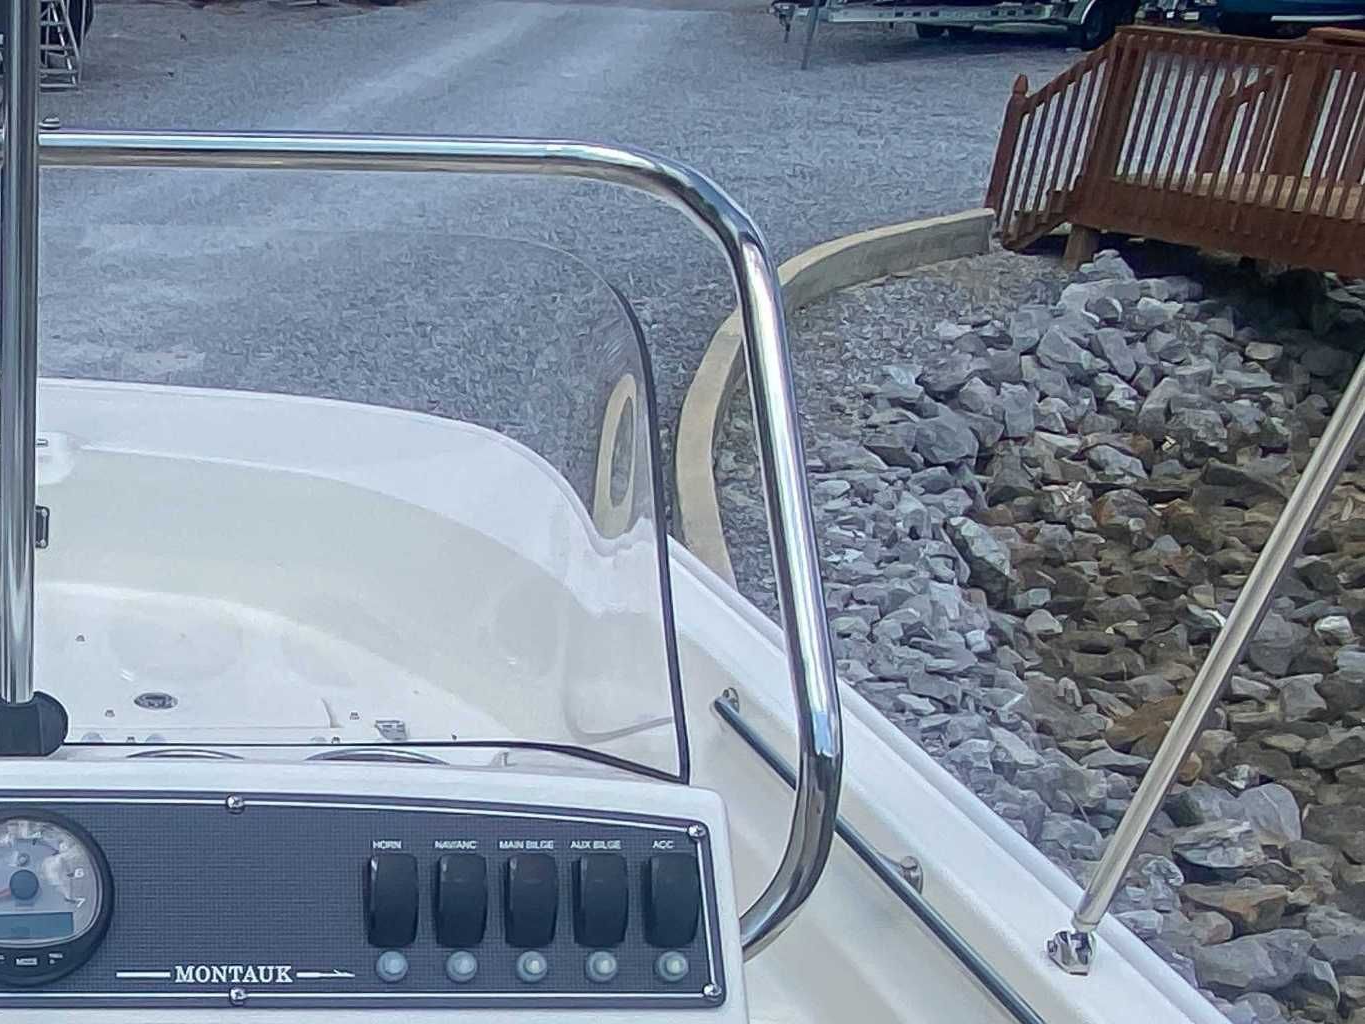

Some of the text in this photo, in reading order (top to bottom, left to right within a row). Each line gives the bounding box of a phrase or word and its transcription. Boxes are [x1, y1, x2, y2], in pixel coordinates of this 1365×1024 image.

[372, 840, 402, 849] HORN
[499, 840, 554, 849] MAIN BILGE
[570, 840, 622, 849] AUX BILGE
[174, 965, 293, 984] MONTAUK
